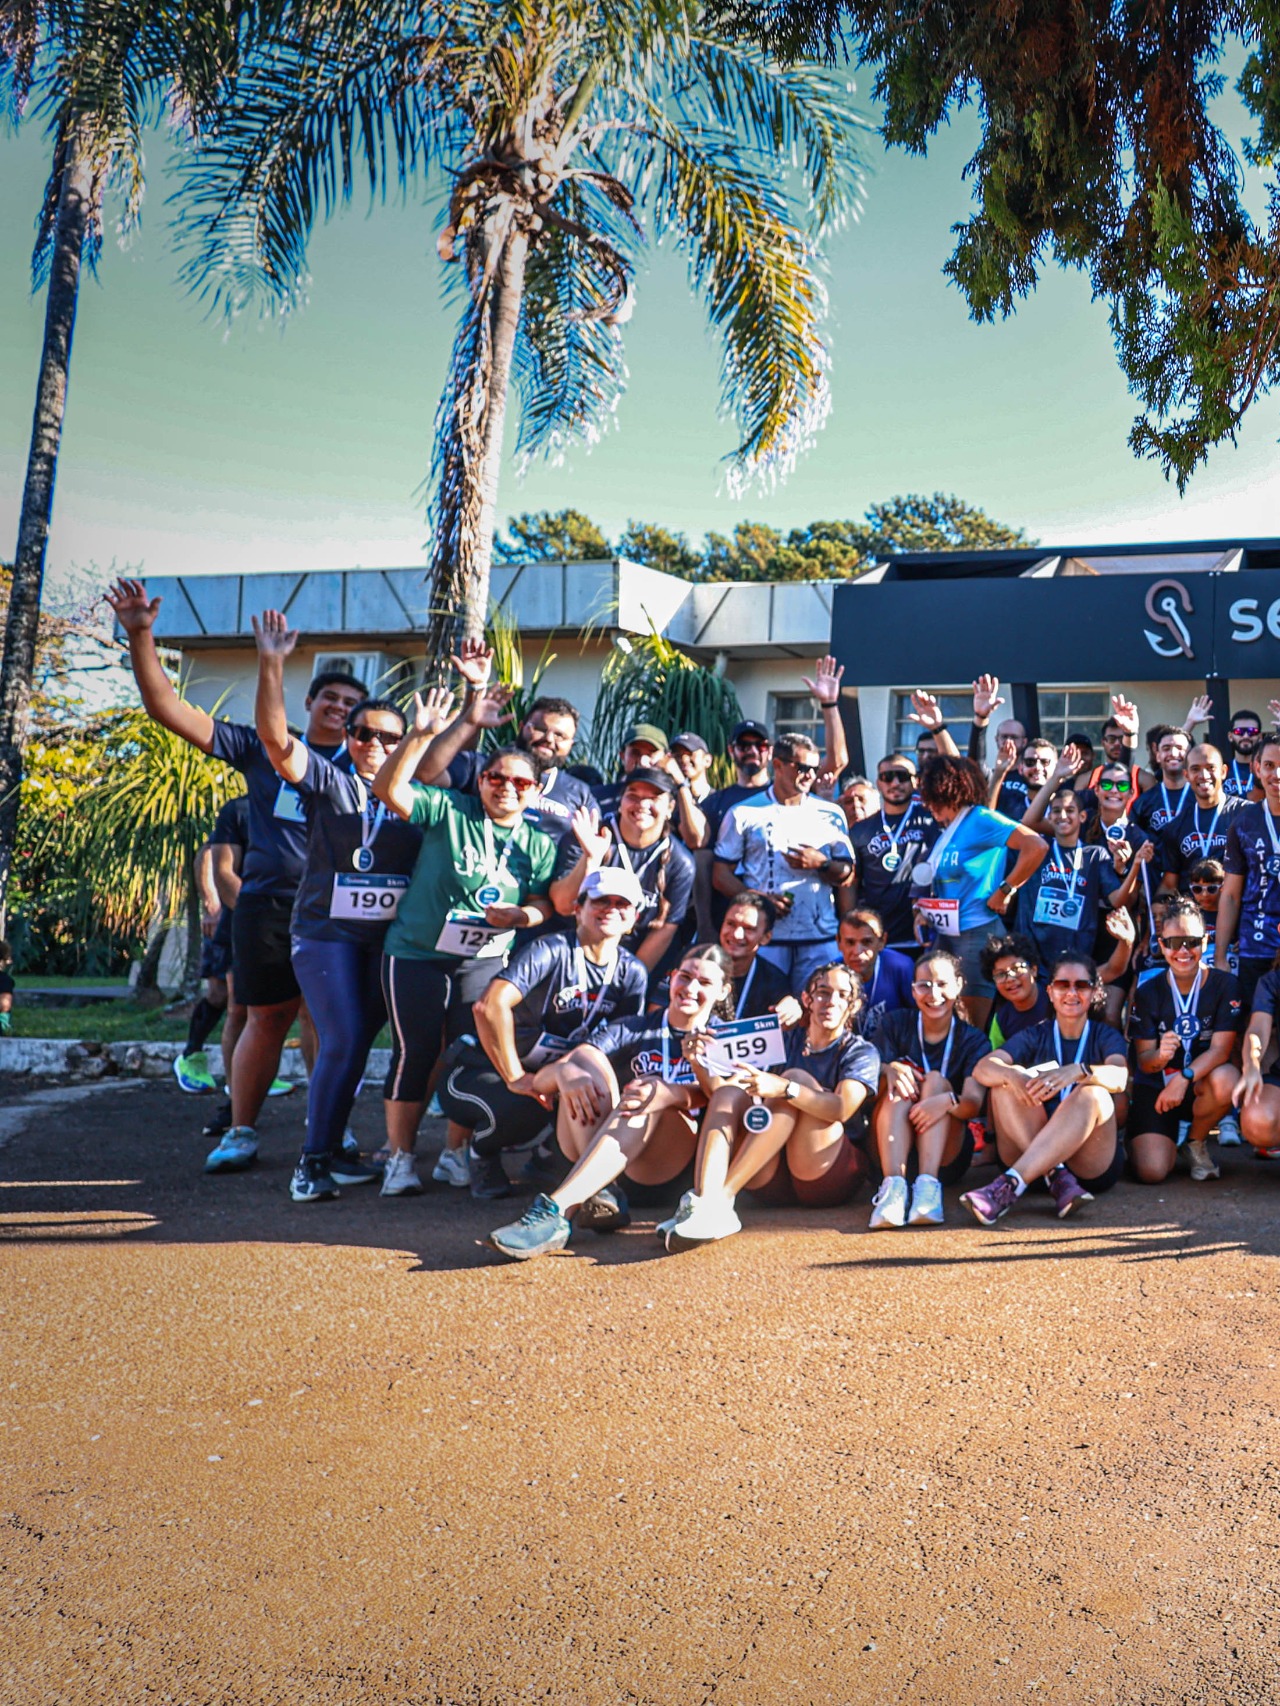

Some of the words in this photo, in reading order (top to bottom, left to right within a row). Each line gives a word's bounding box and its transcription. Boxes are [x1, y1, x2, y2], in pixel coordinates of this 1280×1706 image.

[350, 891, 395, 909] 190
[1043, 901, 1066, 918] 13
[754, 1020, 775, 1030] 5km
[1182, 1019, 1191, 1034] 2
[723, 1037, 767, 1060] 159
